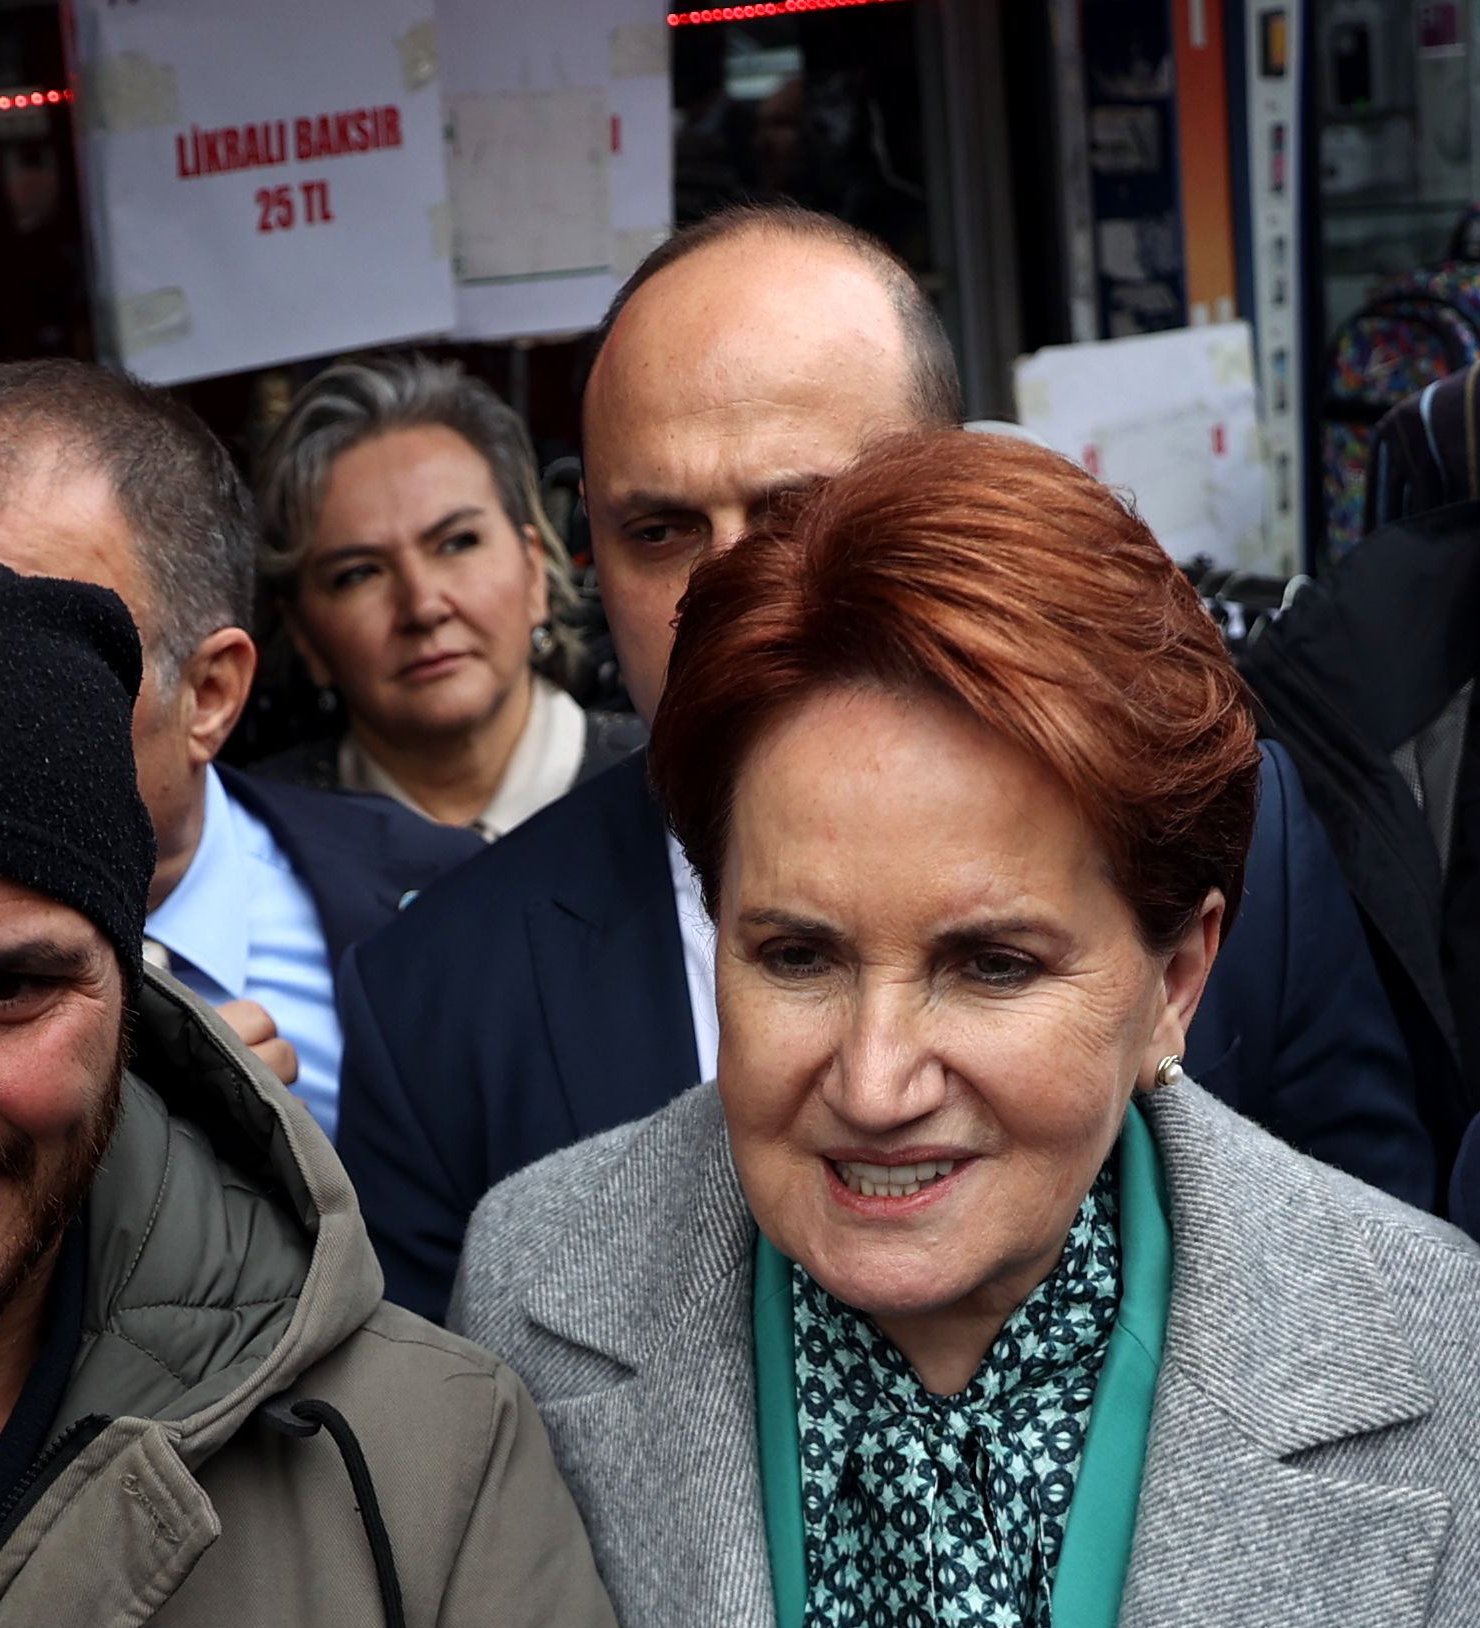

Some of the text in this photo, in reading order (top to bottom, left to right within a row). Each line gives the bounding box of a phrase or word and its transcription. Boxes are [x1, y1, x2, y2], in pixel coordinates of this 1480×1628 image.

[175, 121, 288, 179] LİKRALI
[255, 179, 334, 234] 25 TL
